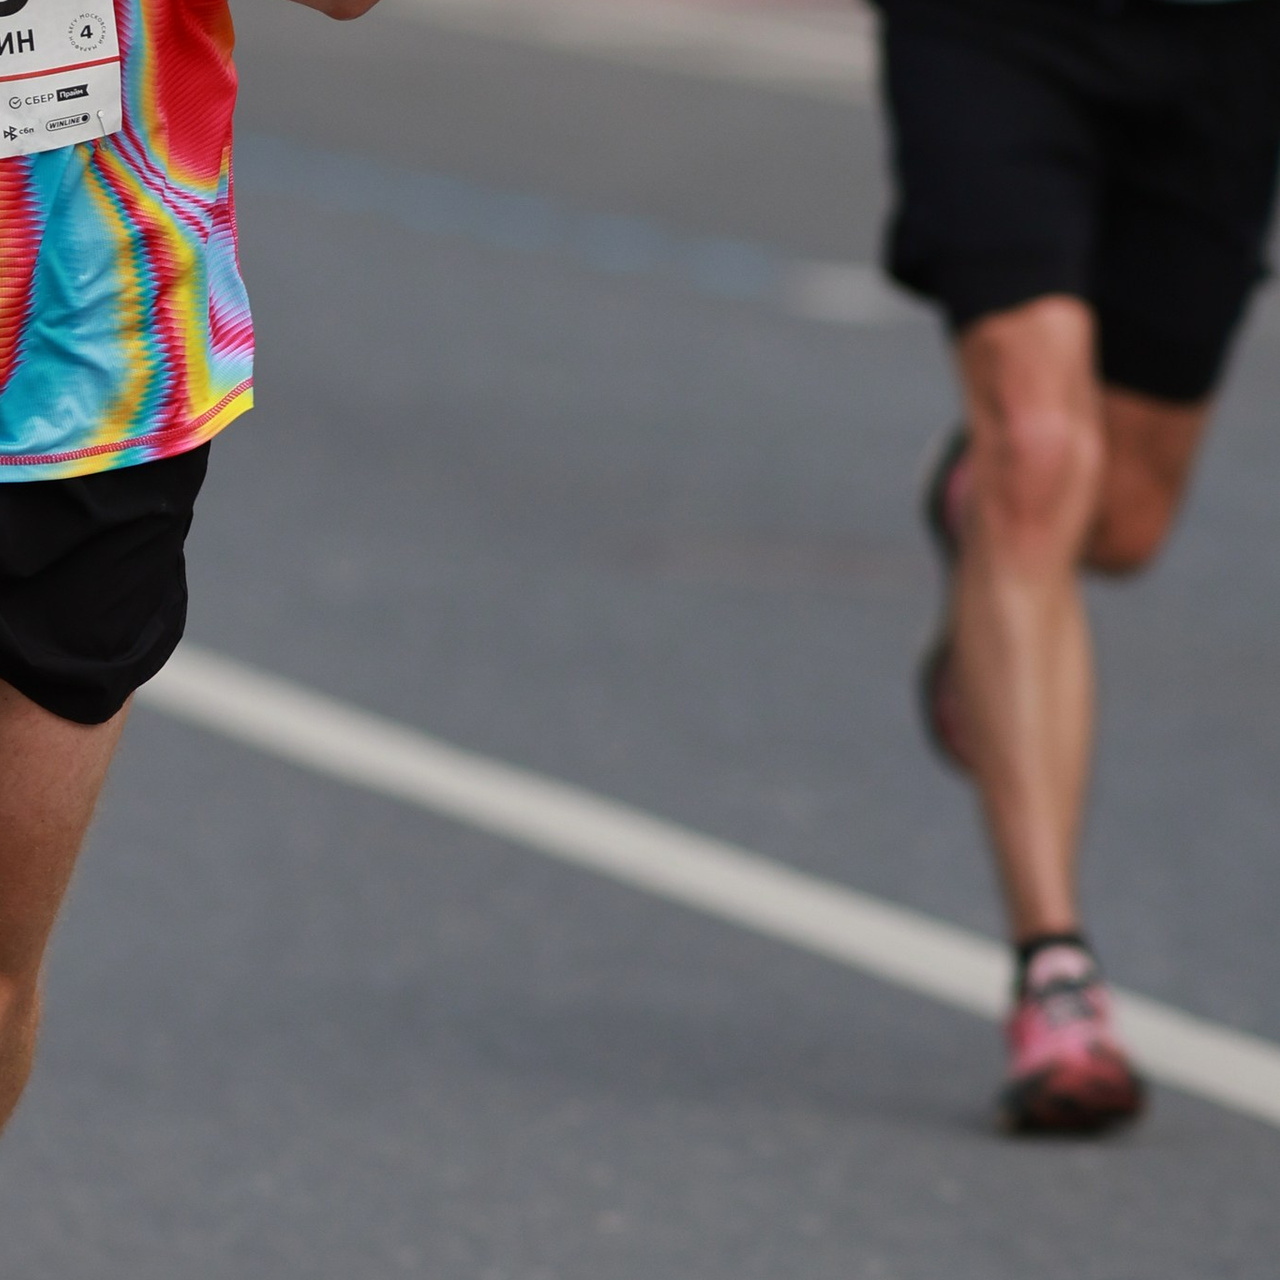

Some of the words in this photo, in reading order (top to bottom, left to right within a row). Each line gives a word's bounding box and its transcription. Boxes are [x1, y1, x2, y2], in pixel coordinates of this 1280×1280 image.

[80, 25, 93, 39] 4
[24, 93, 54, 105] СБЕР
[49, 117, 81, 129] WINLINE
